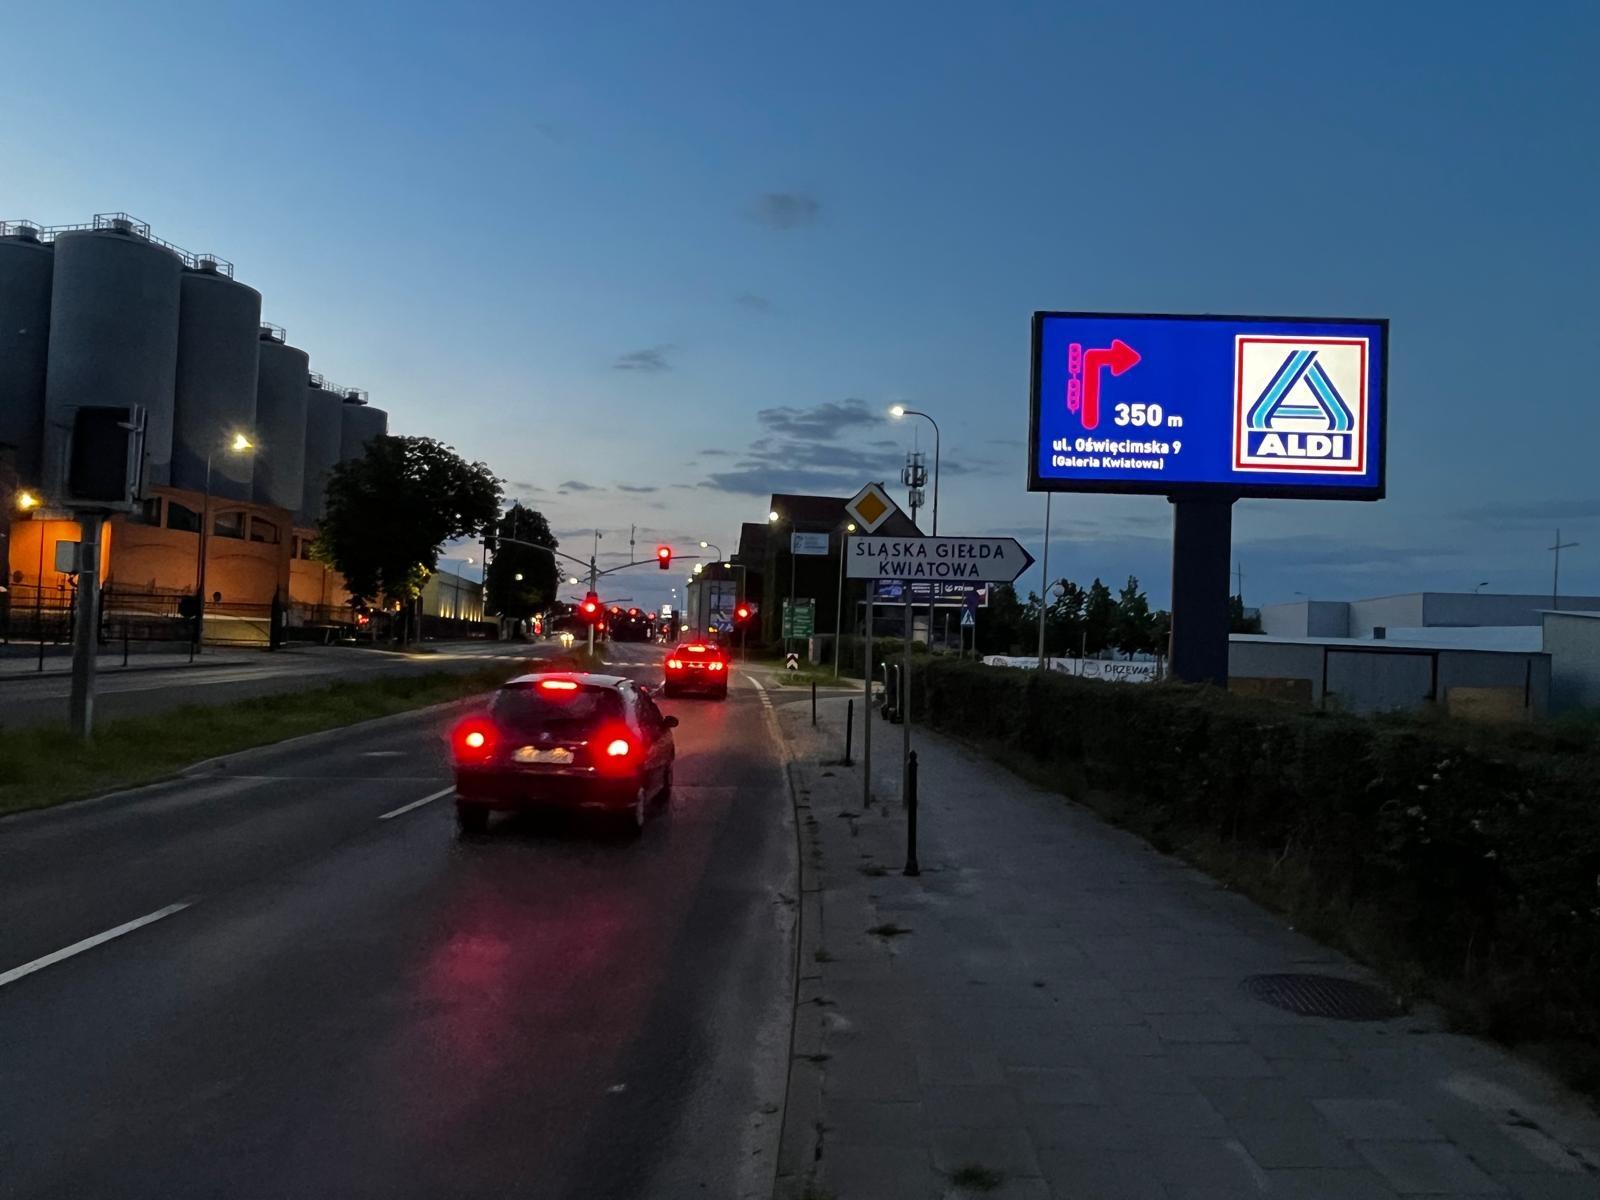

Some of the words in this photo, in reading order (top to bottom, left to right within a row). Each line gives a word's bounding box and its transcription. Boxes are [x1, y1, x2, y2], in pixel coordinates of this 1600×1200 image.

[1114, 402, 1163, 427] 350
[1167, 415, 1183, 427] m
[1052, 438, 1072, 451] ul.
[1075, 437, 1169, 455] Oświęcimska
[1172, 440, 1182, 454] 9
[1256, 433, 1344, 458] ALDI
[935, 543, 1005, 560] GIEŁDA
[879, 561, 980, 577] KWIATOWA
